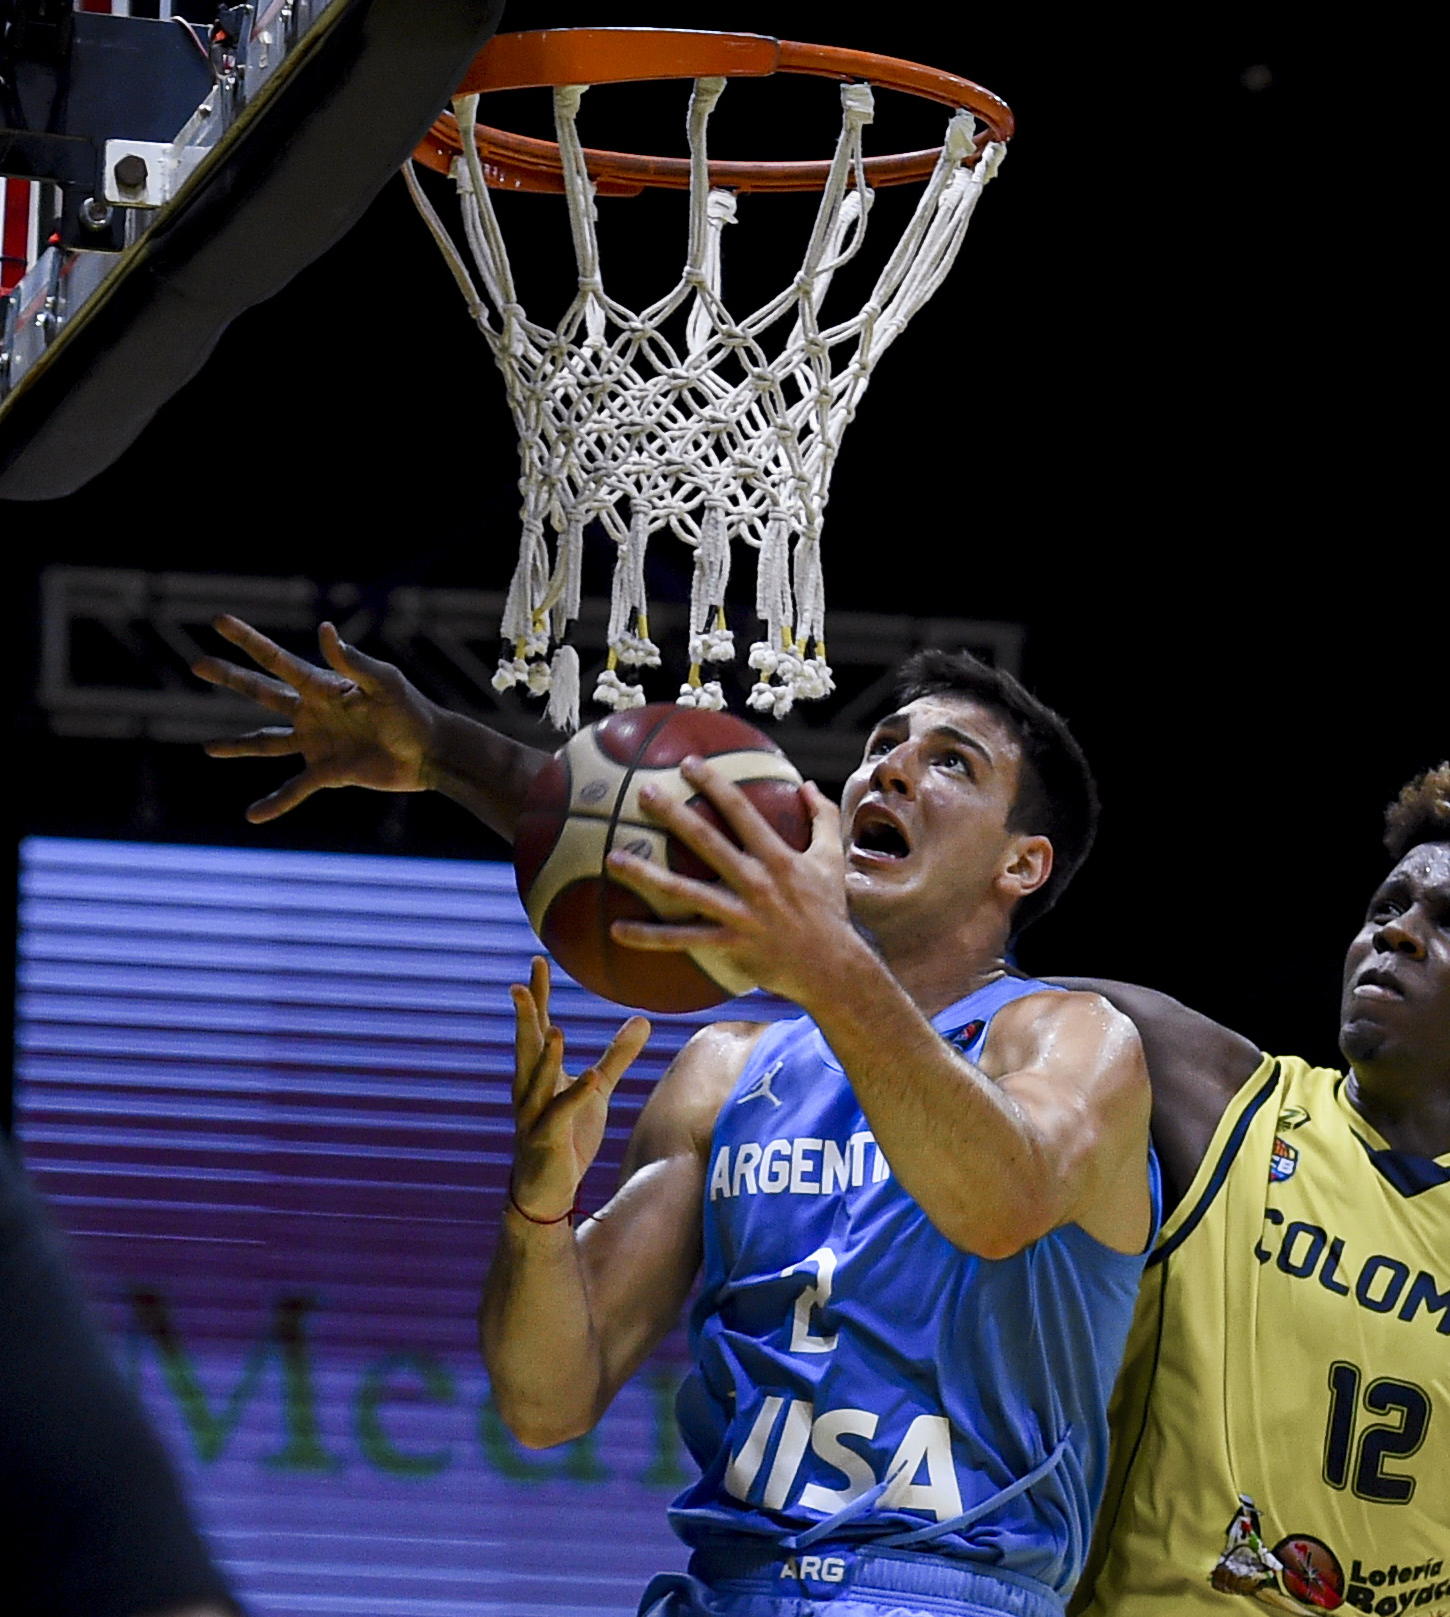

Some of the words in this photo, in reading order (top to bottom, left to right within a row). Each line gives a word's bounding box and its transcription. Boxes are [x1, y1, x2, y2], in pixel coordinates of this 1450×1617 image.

[710, 1130, 892, 1202] ARGENTI
[780, 1247, 839, 1353] 2
[1322, 1360, 1432, 1505] 12
[779, 1555, 844, 1583] ARG
